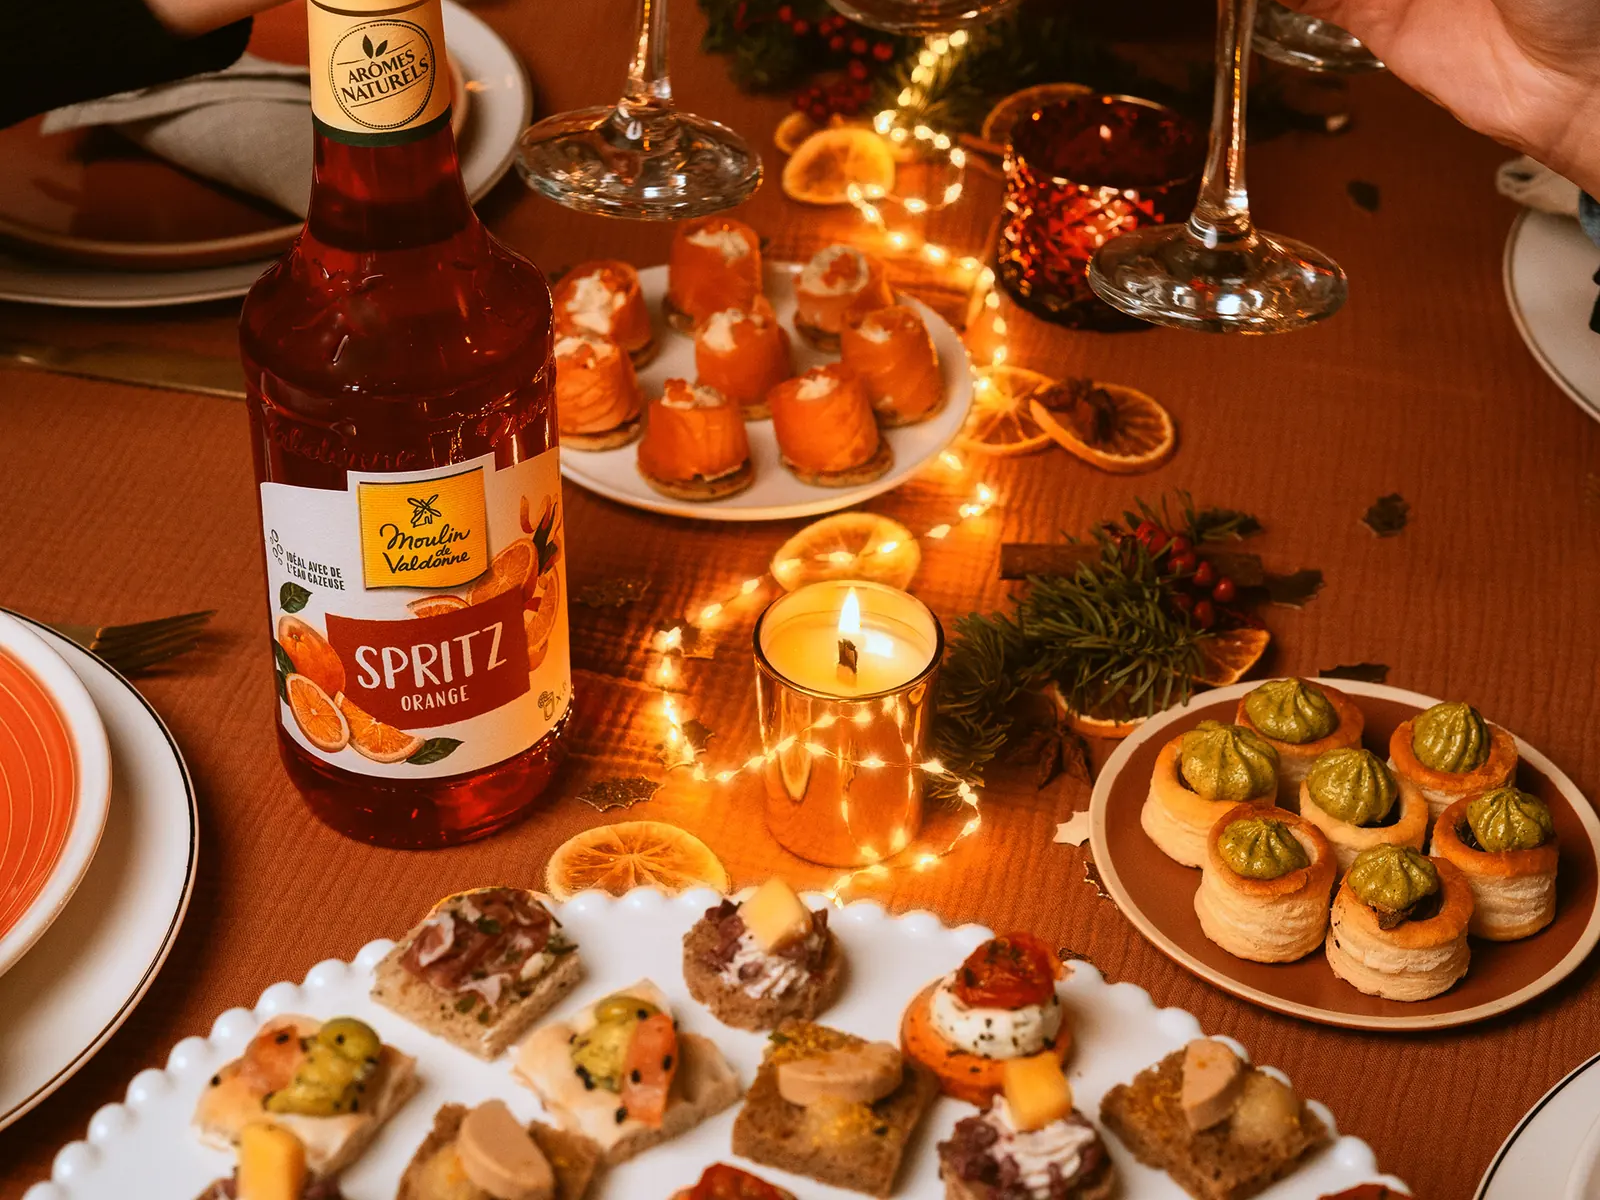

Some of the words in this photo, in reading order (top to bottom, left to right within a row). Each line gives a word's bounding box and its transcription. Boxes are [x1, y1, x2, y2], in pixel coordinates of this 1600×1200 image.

[349, 49, 415, 84] ARÔMES
[379, 523, 471, 550] Moulin
[286, 551, 307, 569] IDÉAL
[308, 560, 329, 576] AVEC
[330, 566, 343, 579] DE
[382, 551, 471, 574] Valdonne
[435, 545, 452, 557] de
[286, 562, 307, 581] L'EAU
[307, 572, 346, 591] GAZEUSE
[355, 621, 507, 689] SPRITZ
[401, 684, 470, 712] ORANGE
